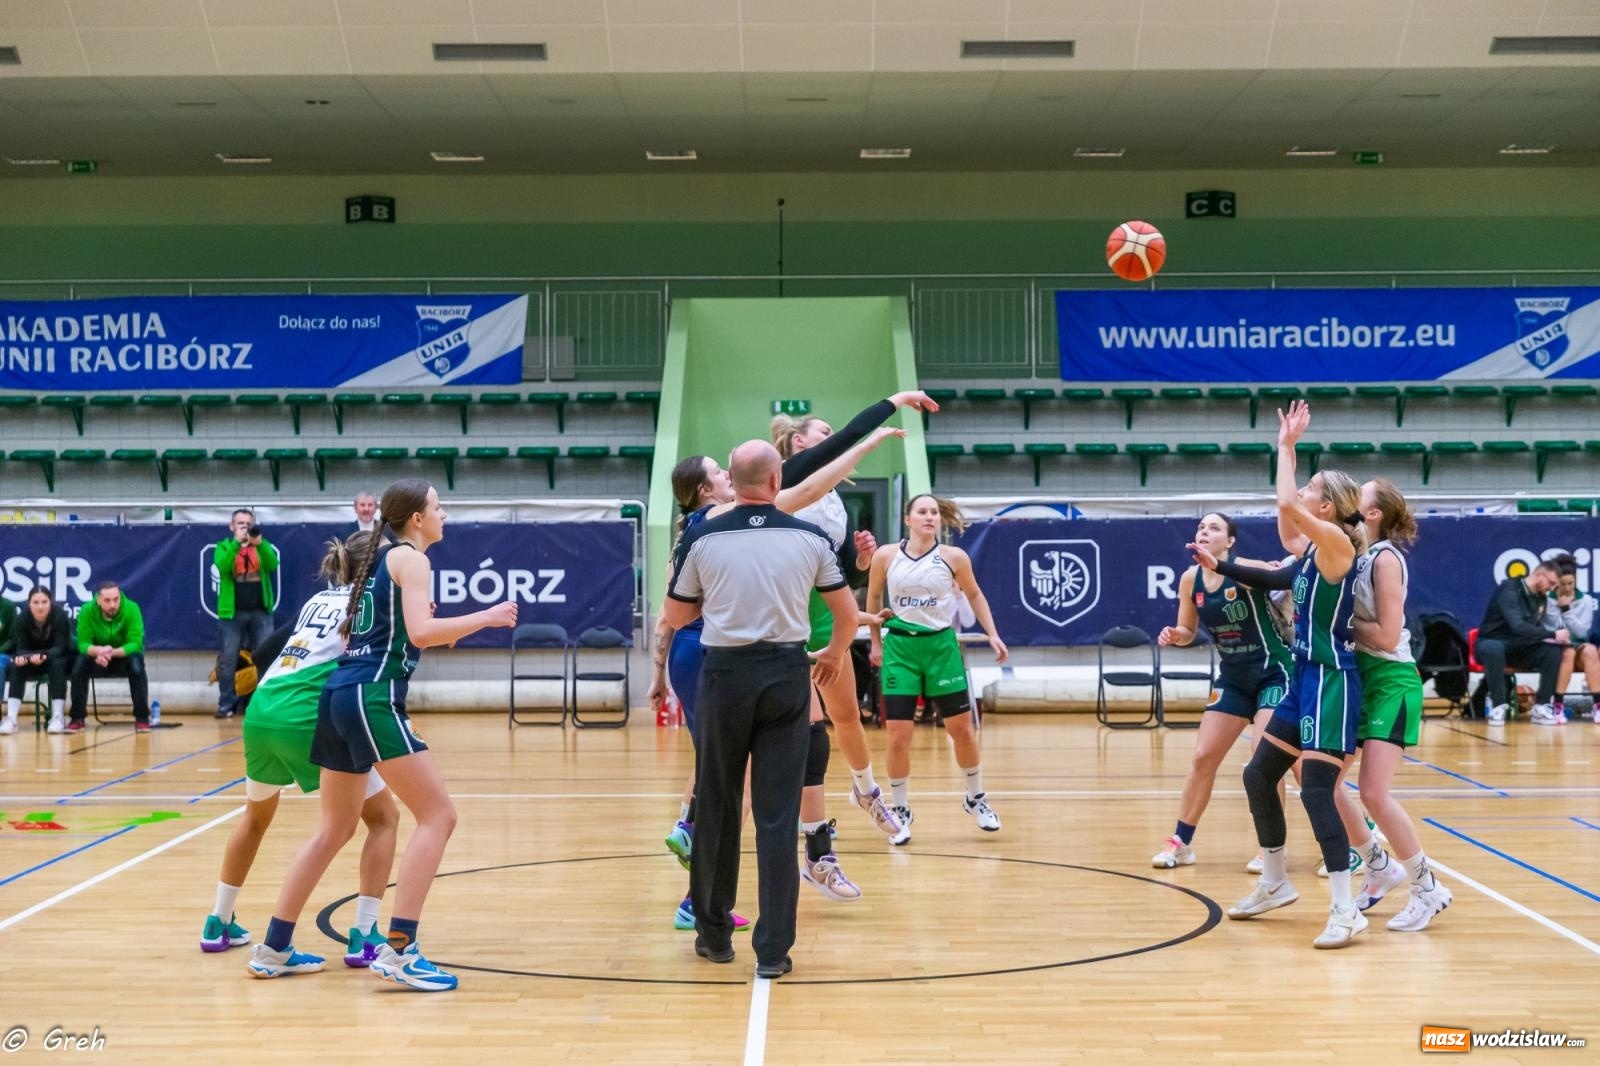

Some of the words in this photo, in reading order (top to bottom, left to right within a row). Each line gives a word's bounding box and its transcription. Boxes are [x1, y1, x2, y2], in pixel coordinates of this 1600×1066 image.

[350, 205, 361, 220] B
[372, 204, 389, 220] B
[1191, 199, 1208, 215] C
[1219, 199, 1232, 215] C
[0, 312, 167, 342] KADEMIA
[279, 314, 326, 332] Dołącz
[330, 315, 347, 329] do
[352, 315, 381, 329] nas!
[1098, 317, 1455, 349] www.uniaraciborz.eu
[421, 331, 464, 359] UNIA
[1520, 323, 1563, 351] UNIA
[0, 346, 55, 373] NII
[70, 337, 253, 373] RACIBÓRZ
[0, 556, 94, 602] SiR
[428, 557, 566, 604] IBÓRZ
[899, 595, 937, 608] Clavis
[1222, 600, 1249, 623] 10
[293, 602, 341, 639] 14
[1258, 686, 1284, 706] 10
